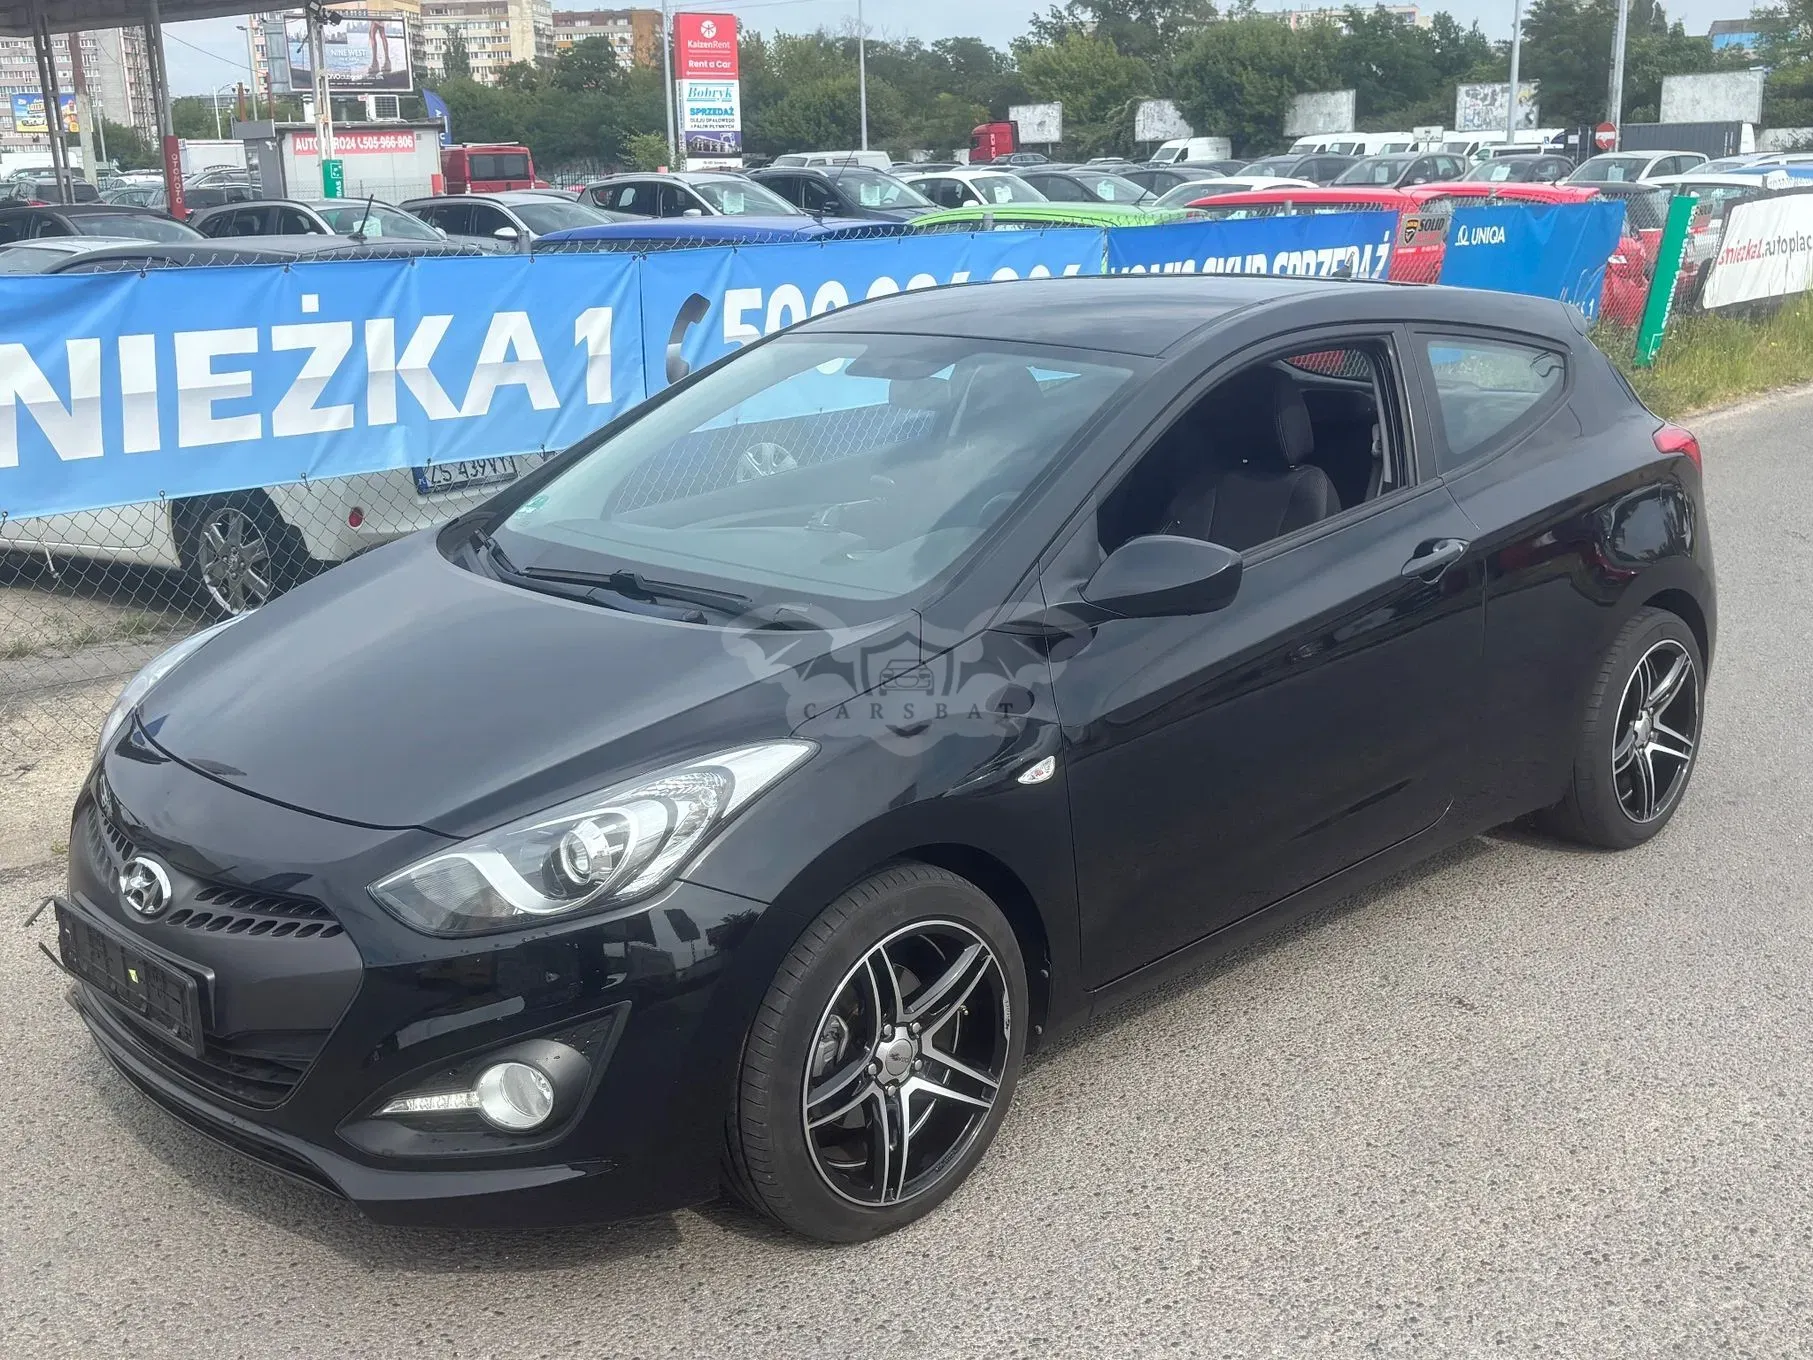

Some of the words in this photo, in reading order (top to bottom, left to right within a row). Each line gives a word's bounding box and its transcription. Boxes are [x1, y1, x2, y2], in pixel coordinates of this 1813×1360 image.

[688, 40, 730, 49] KaizenRent
[688, 60, 708, 68] Rent
[716, 60, 731, 68] Car
[688, 87, 732, 100] Bobryk
[690, 106, 735, 117] SPRZEDAŻ
[171, 153, 182, 204] OTOMOTO
[1419, 218, 1444, 231] SOLID
[1471, 226, 1505, 245] UNIQA
